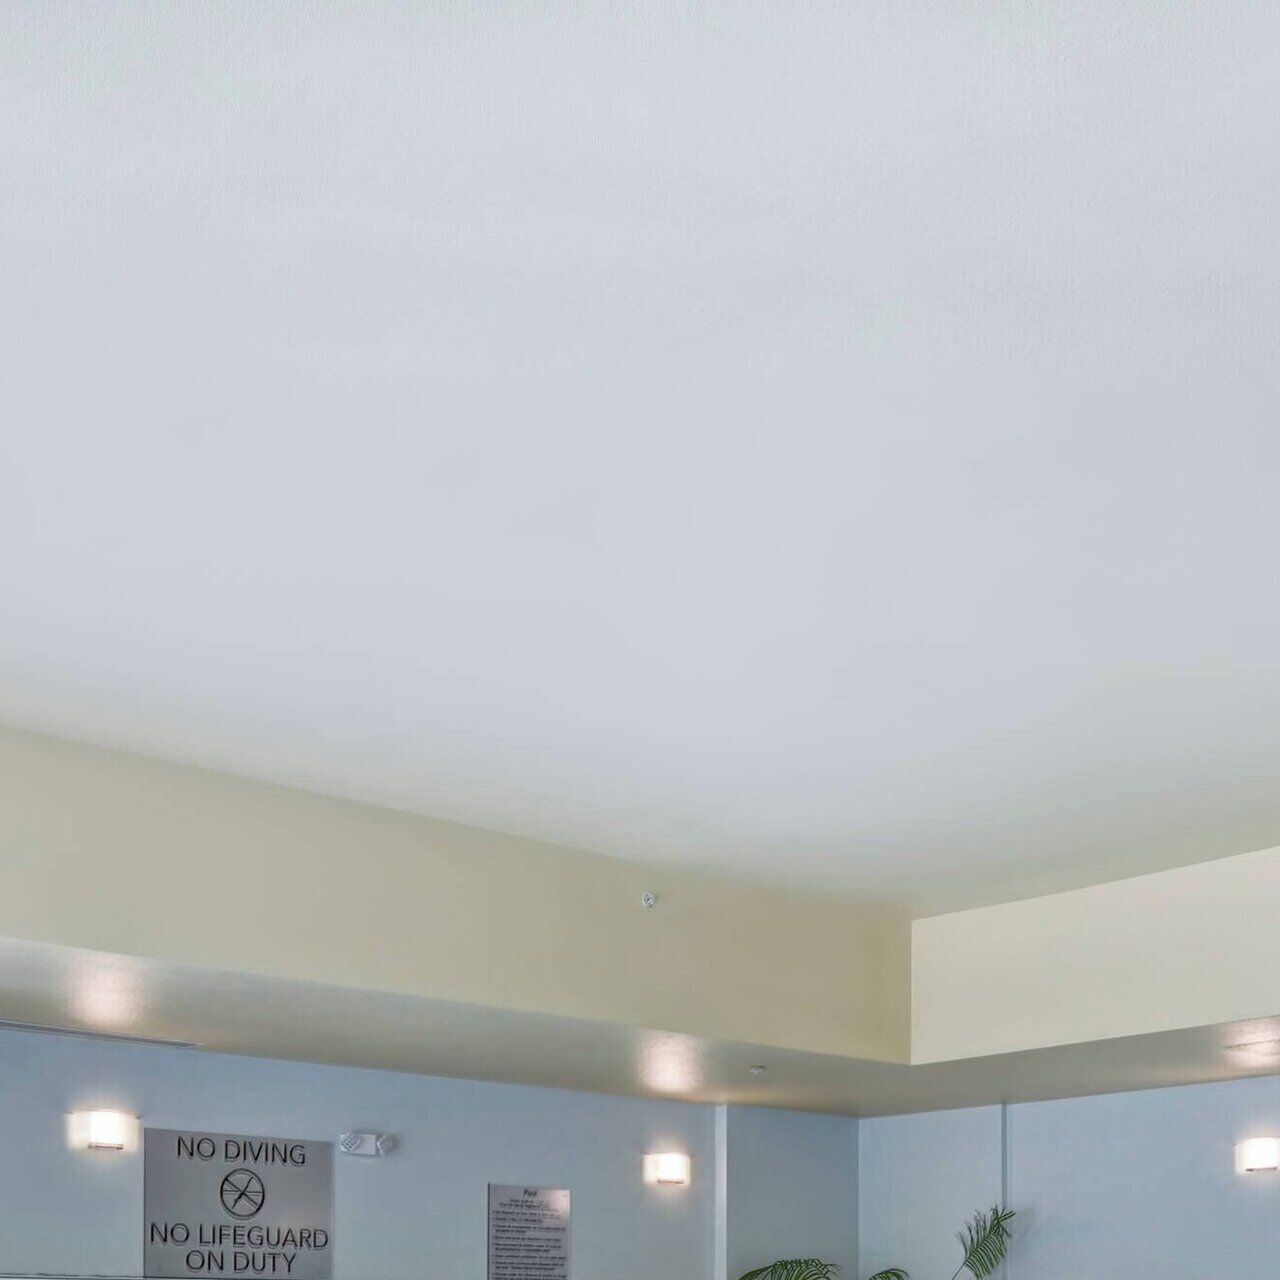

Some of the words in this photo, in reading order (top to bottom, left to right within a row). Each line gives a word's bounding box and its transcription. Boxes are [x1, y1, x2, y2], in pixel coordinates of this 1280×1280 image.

[177, 1136, 216, 1160] NO
[224, 1139, 306, 1165] DIVING
[150, 1222, 190, 1245] NO
[199, 1223, 329, 1249] LIFEGUARD
[186, 1250, 224, 1272] ON
[233, 1251, 297, 1274] DUTY
